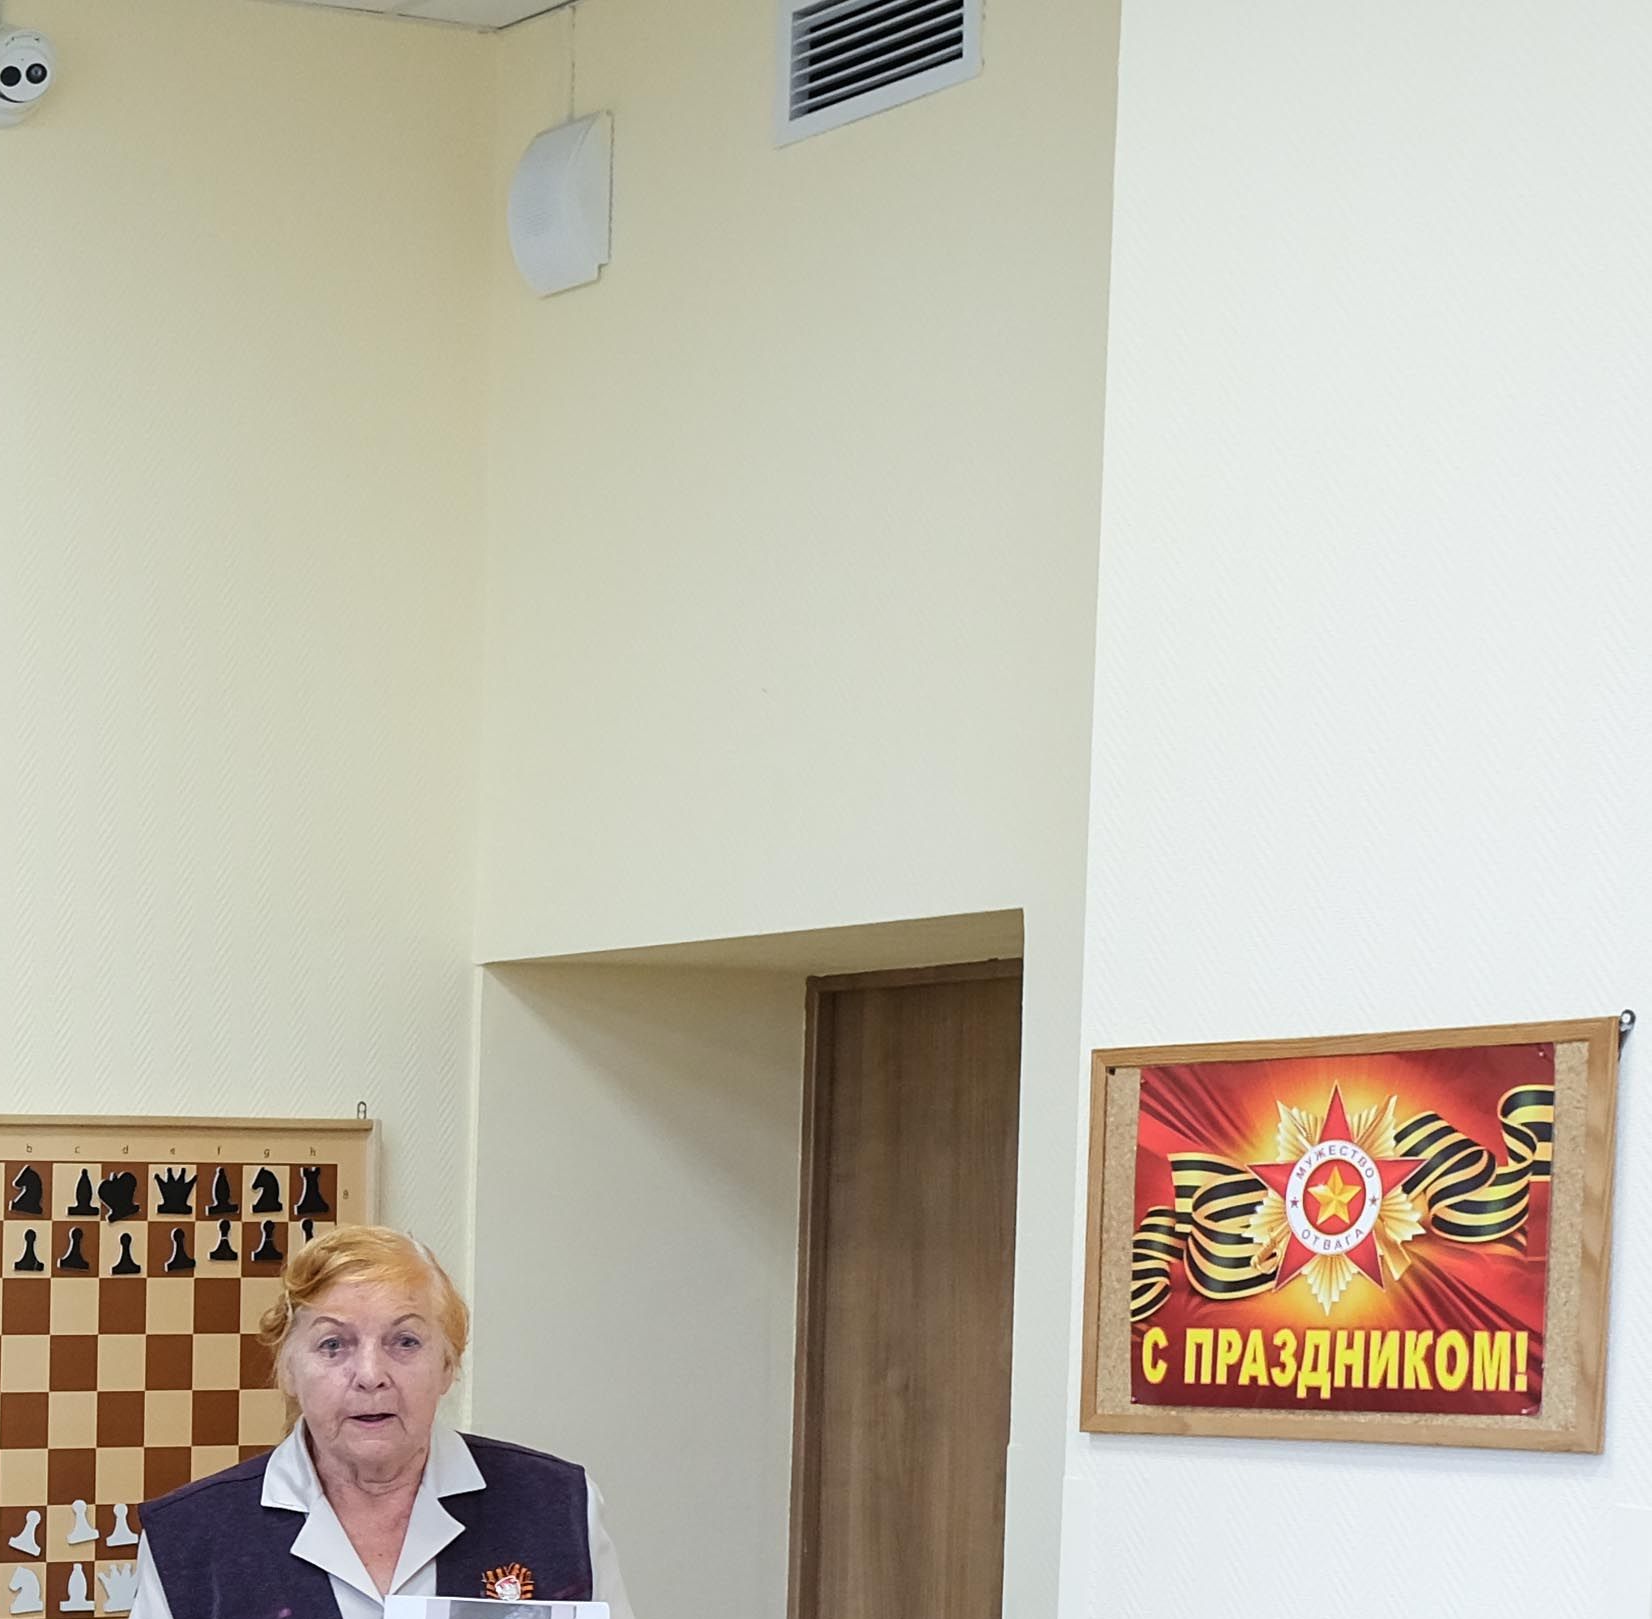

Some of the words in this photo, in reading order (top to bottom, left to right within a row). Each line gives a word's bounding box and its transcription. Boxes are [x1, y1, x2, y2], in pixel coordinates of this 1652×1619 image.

[1296, 1144, 1375, 1180] МУЖЕСТВО
[1301, 1228, 1364, 1251] ОТВАГА
[1141, 1326, 1170, 1385] С
[1183, 1327, 1529, 1400] ПРАЗДНИКОМ!
